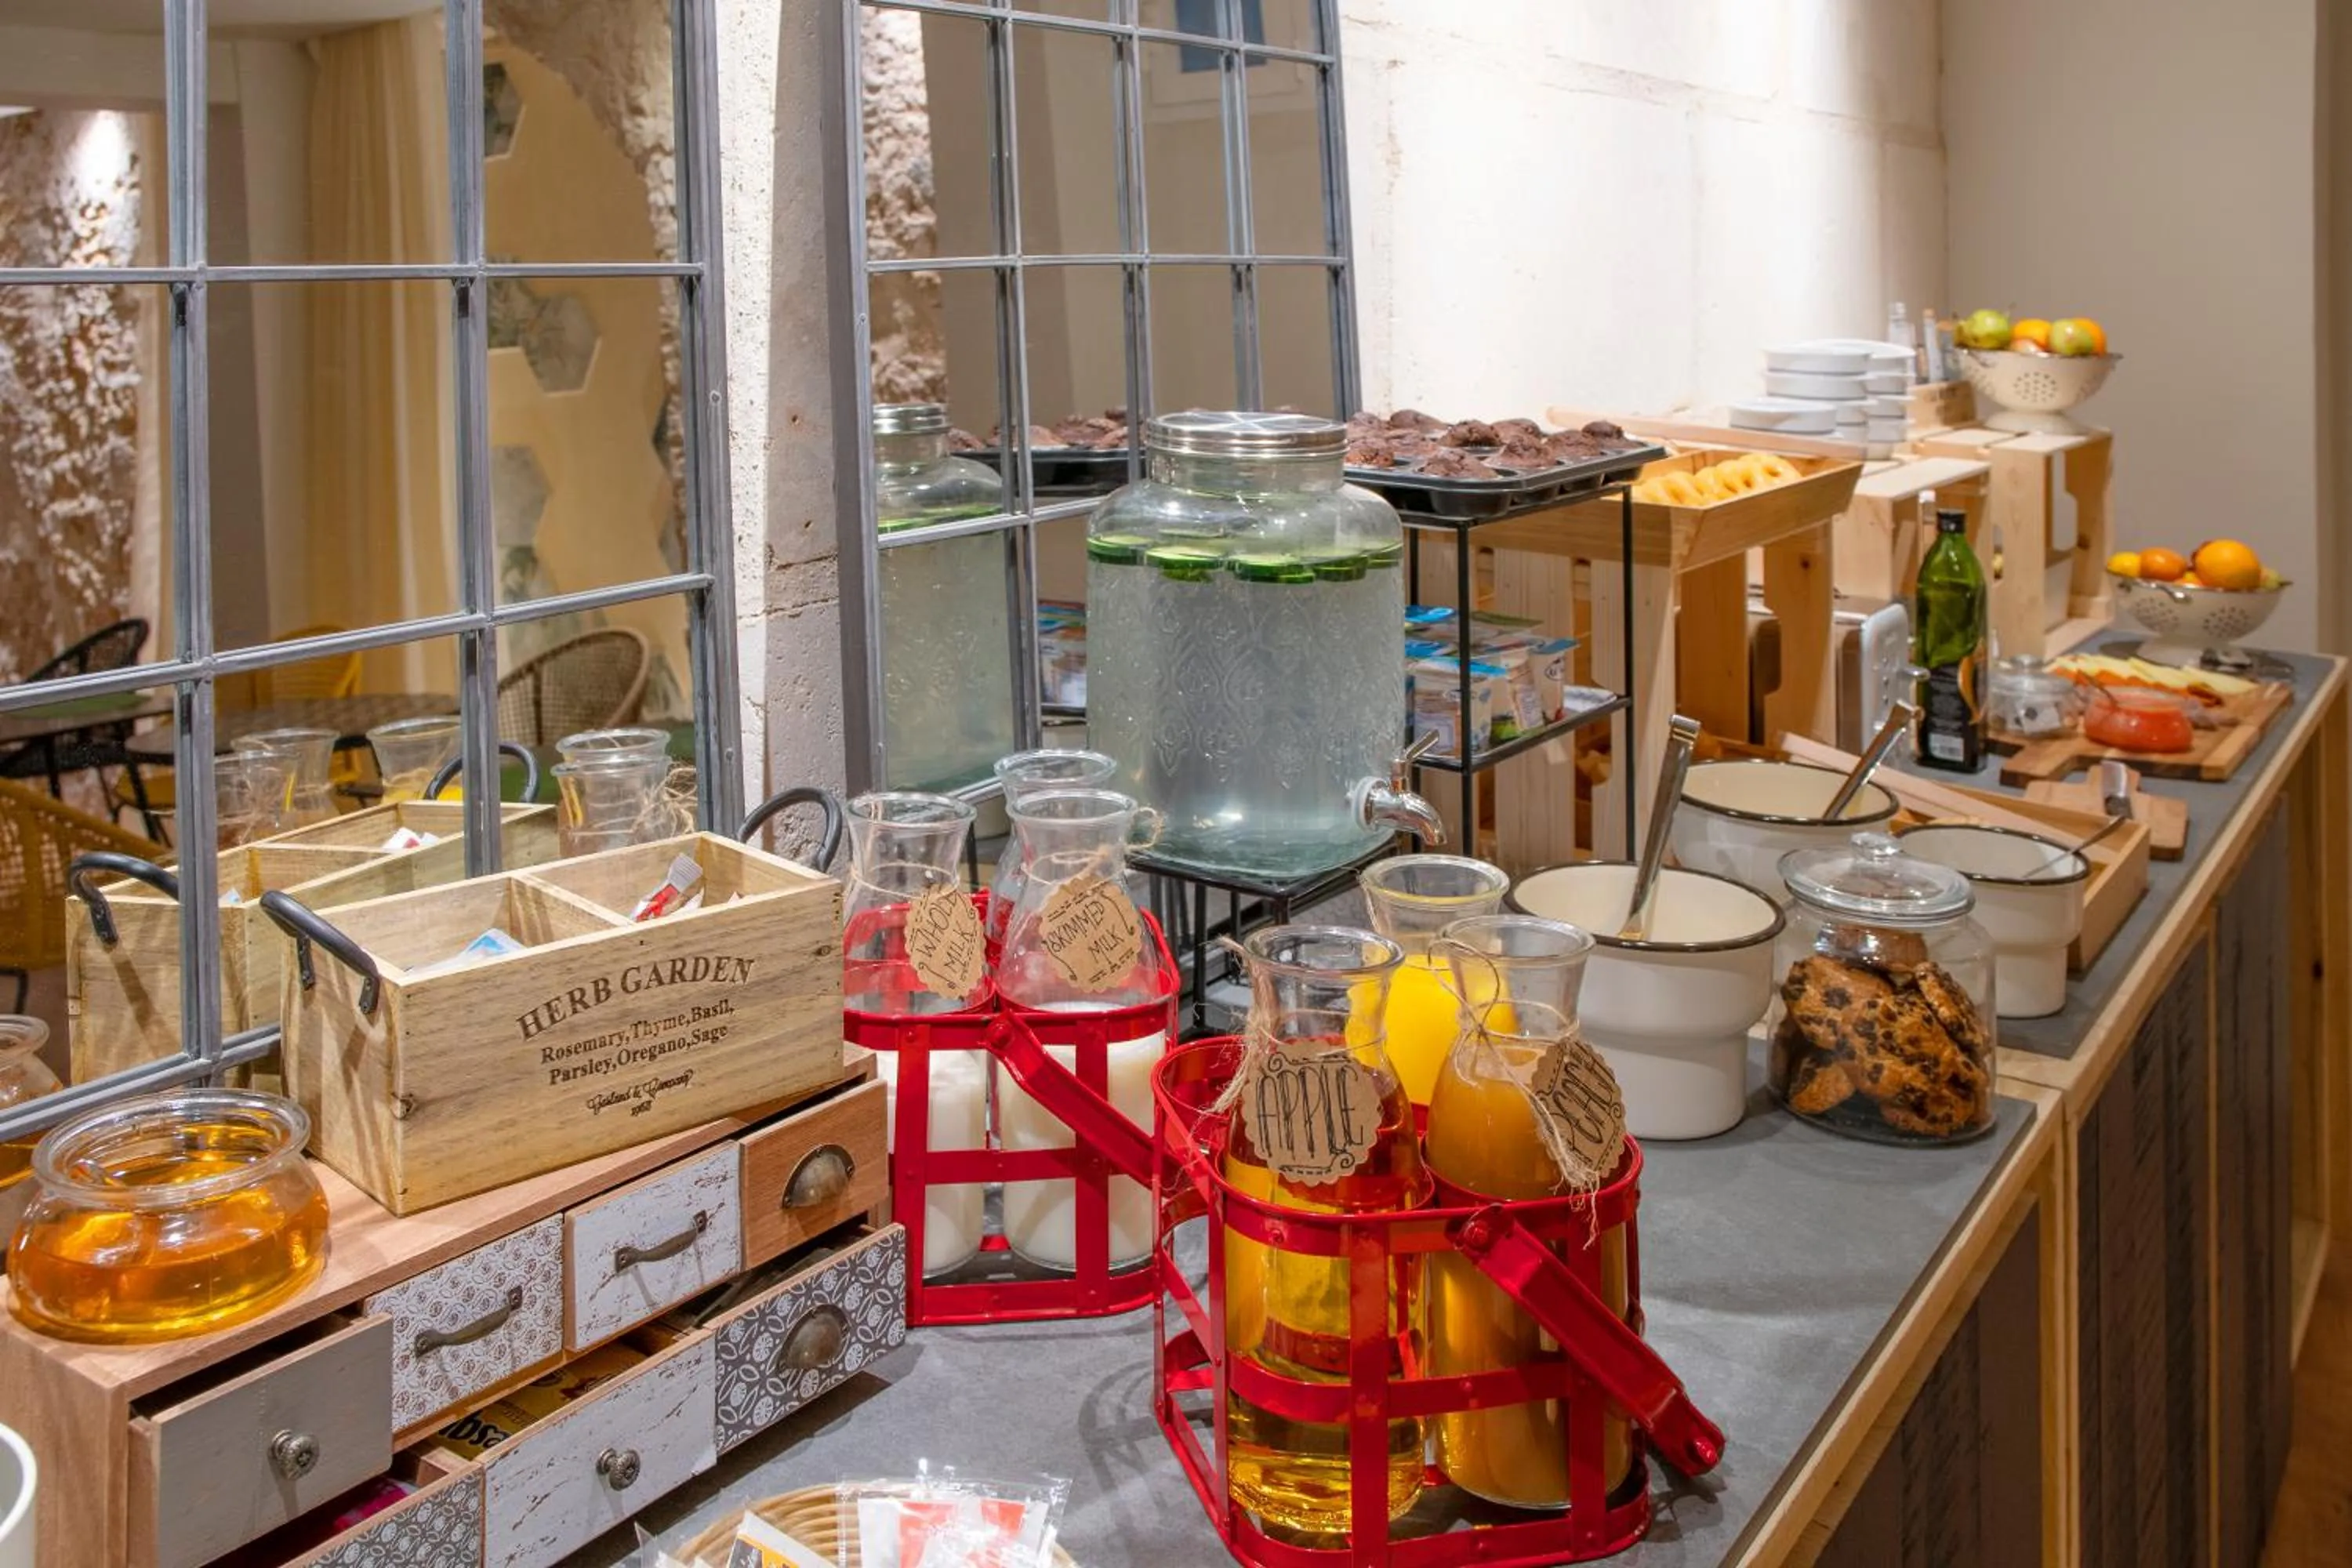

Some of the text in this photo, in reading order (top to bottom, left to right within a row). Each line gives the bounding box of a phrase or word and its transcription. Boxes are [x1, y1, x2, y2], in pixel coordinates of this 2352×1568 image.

[944, 920, 975, 972] MILK
[1087, 925, 1125, 964] MILK
[516, 956, 755, 1041] HERB GARDEN
[1257, 1064, 1363, 1160] APPLE
